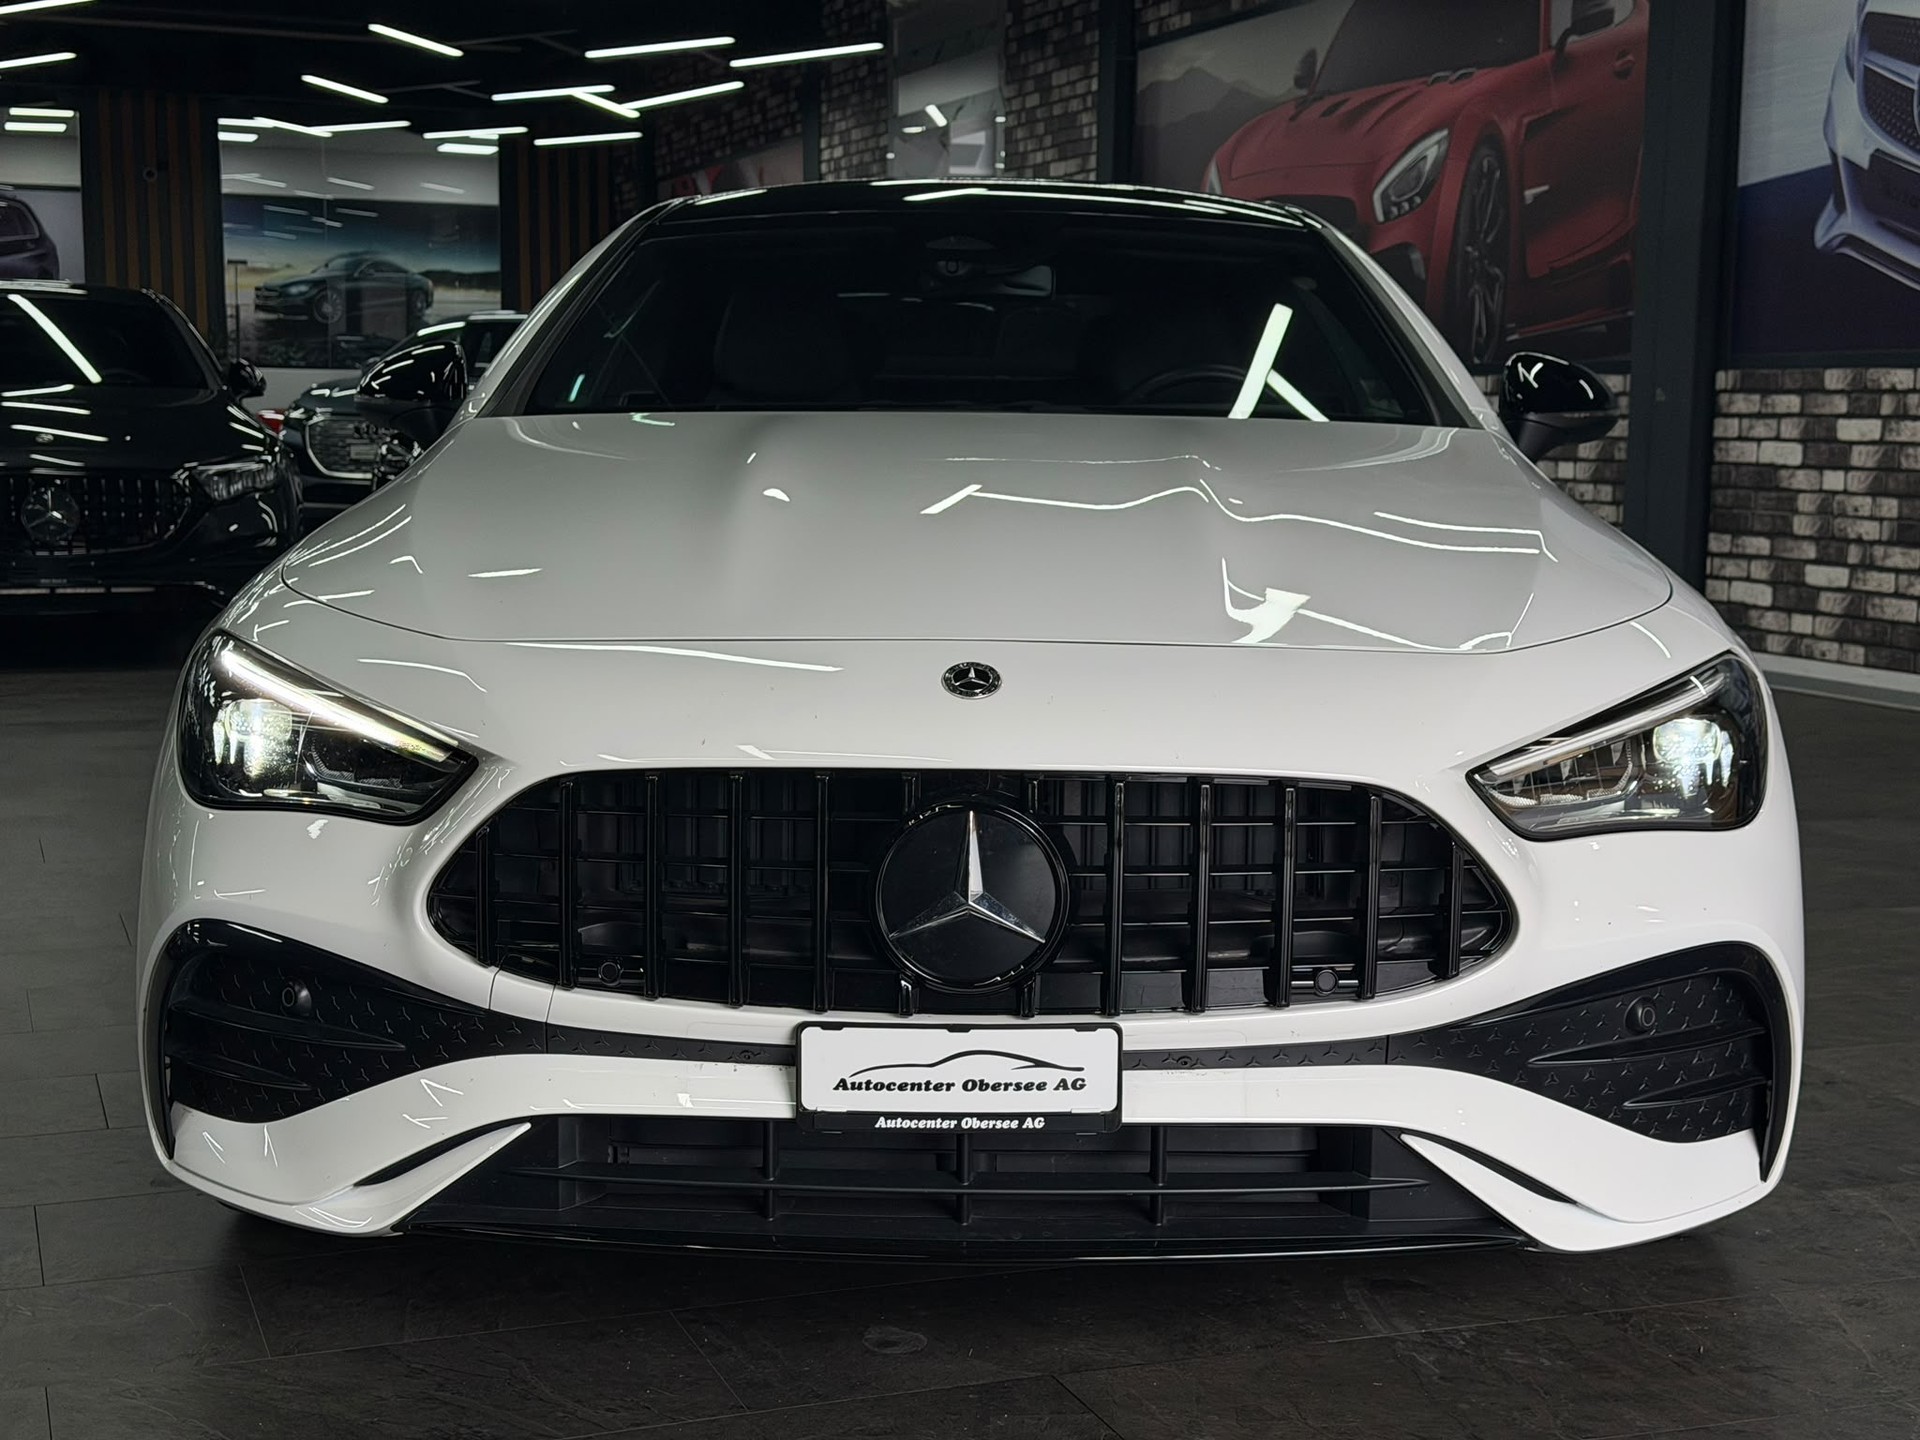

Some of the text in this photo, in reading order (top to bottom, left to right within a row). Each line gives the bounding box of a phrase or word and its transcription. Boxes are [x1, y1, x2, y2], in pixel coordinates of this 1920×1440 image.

[833, 1077, 1087, 1092] Autocenter Obersee AG
[874, 1116, 1046, 1130] Autocenter Obersee AG
